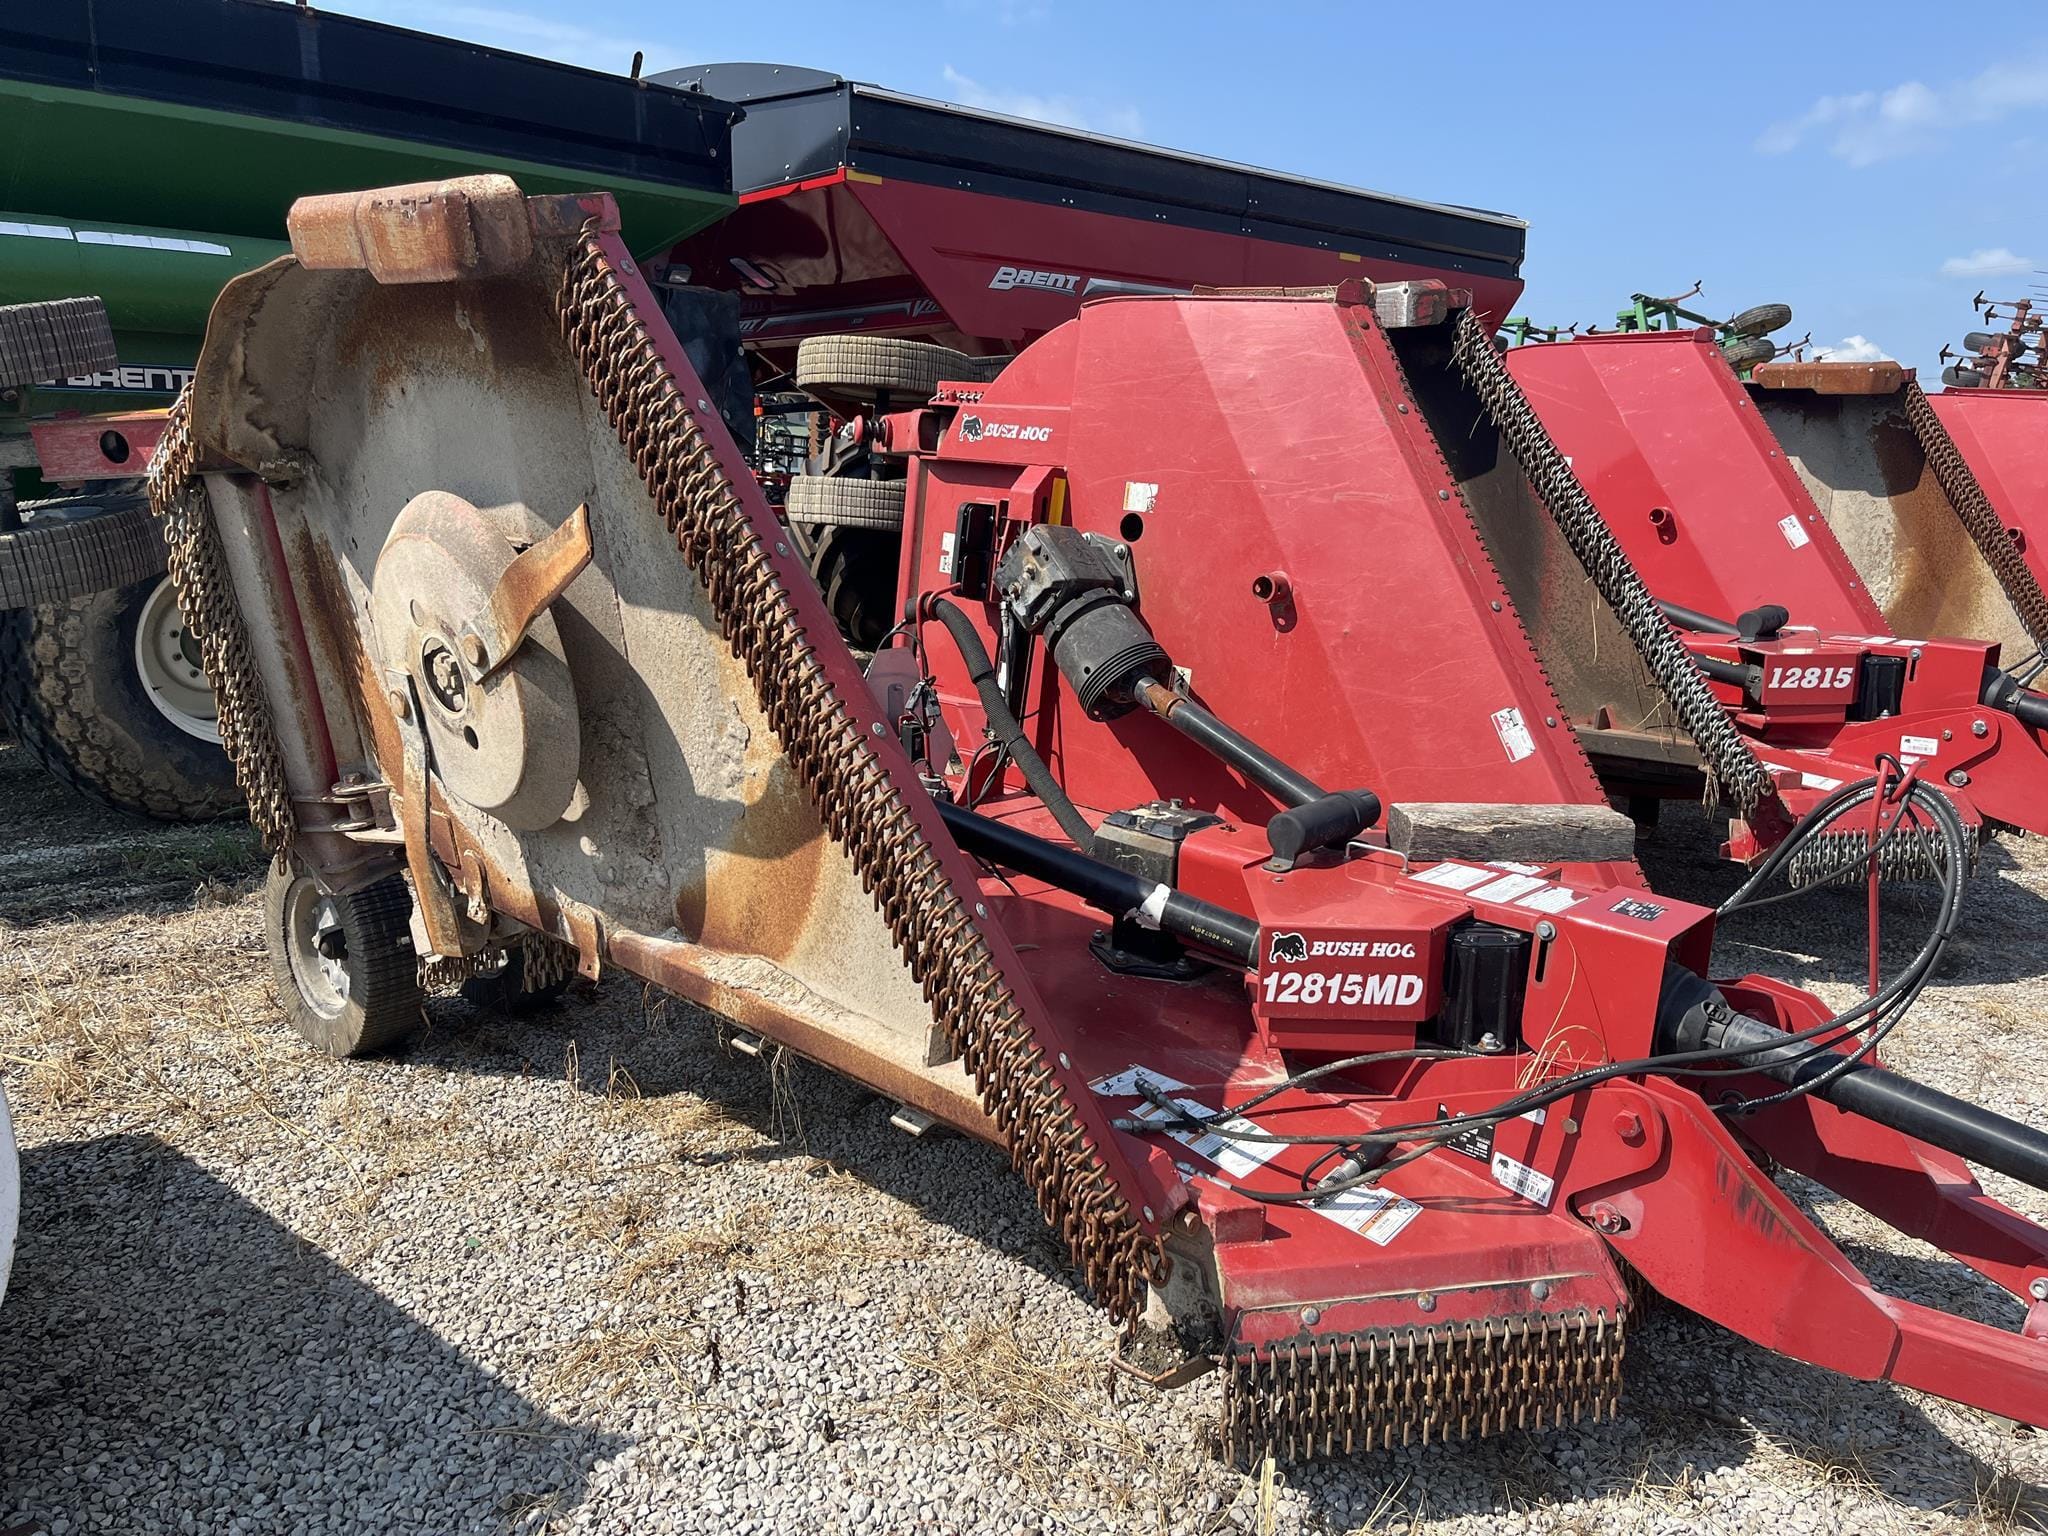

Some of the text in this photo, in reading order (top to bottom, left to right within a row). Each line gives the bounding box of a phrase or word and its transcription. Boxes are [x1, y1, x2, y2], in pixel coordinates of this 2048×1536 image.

[988, 267, 1081, 290] BRENT
[983, 423, 1050, 442] BUSH HOG
[1768, 667, 1854, 689] 12815
[1310, 941, 1416, 958] BUSH HOG
[1263, 971, 1424, 1006] 12815MD
